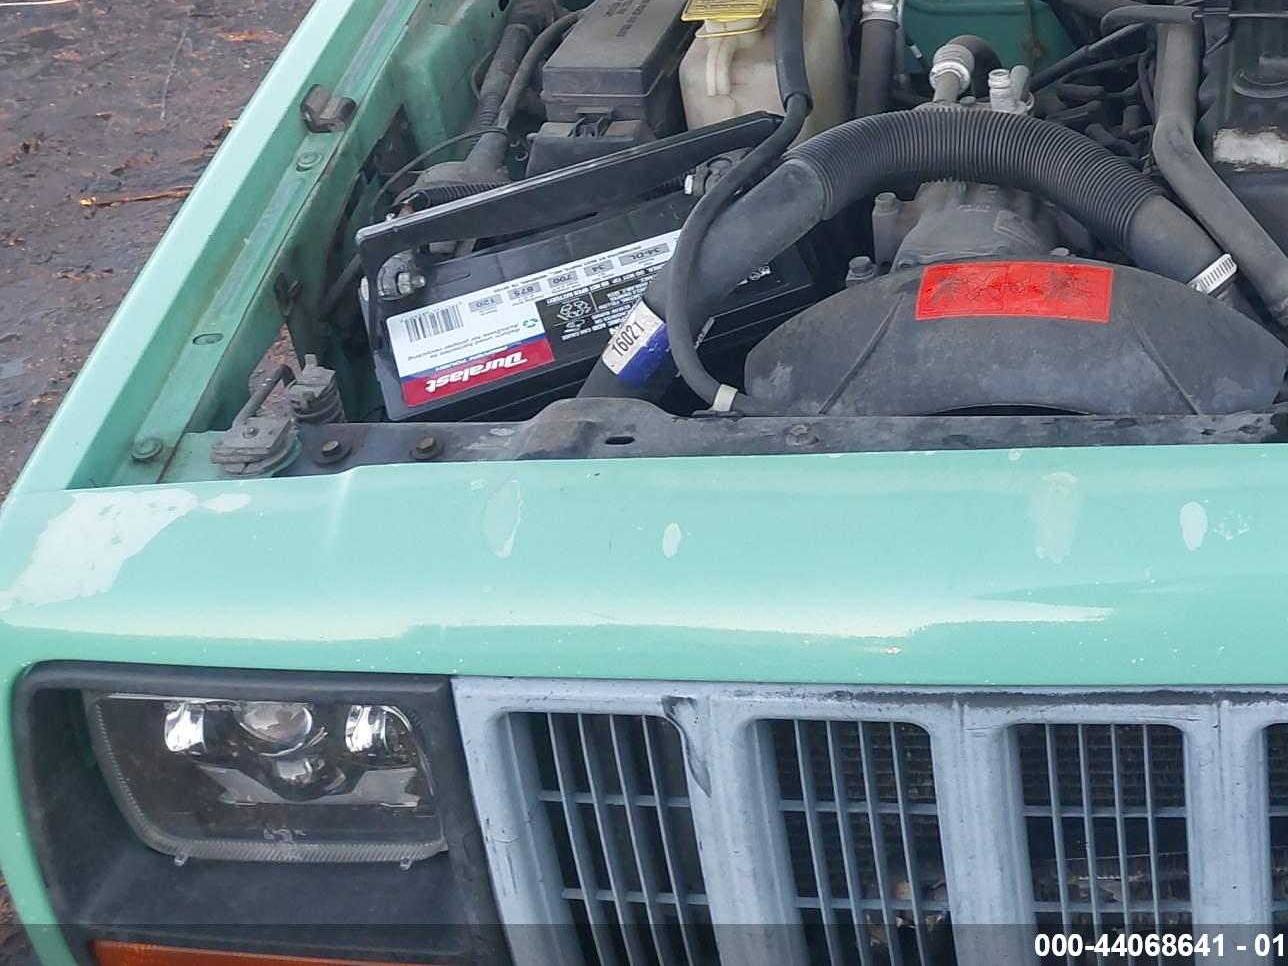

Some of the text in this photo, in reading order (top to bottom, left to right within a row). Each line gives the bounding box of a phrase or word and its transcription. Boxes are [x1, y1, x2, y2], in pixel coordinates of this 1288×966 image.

[591, 264, 605, 273] 34
[552, 274, 573, 284] 700
[475, 297, 496, 309] 120
[612, 321, 645, 356] 16021
[425, 351, 528, 393] Duralast
